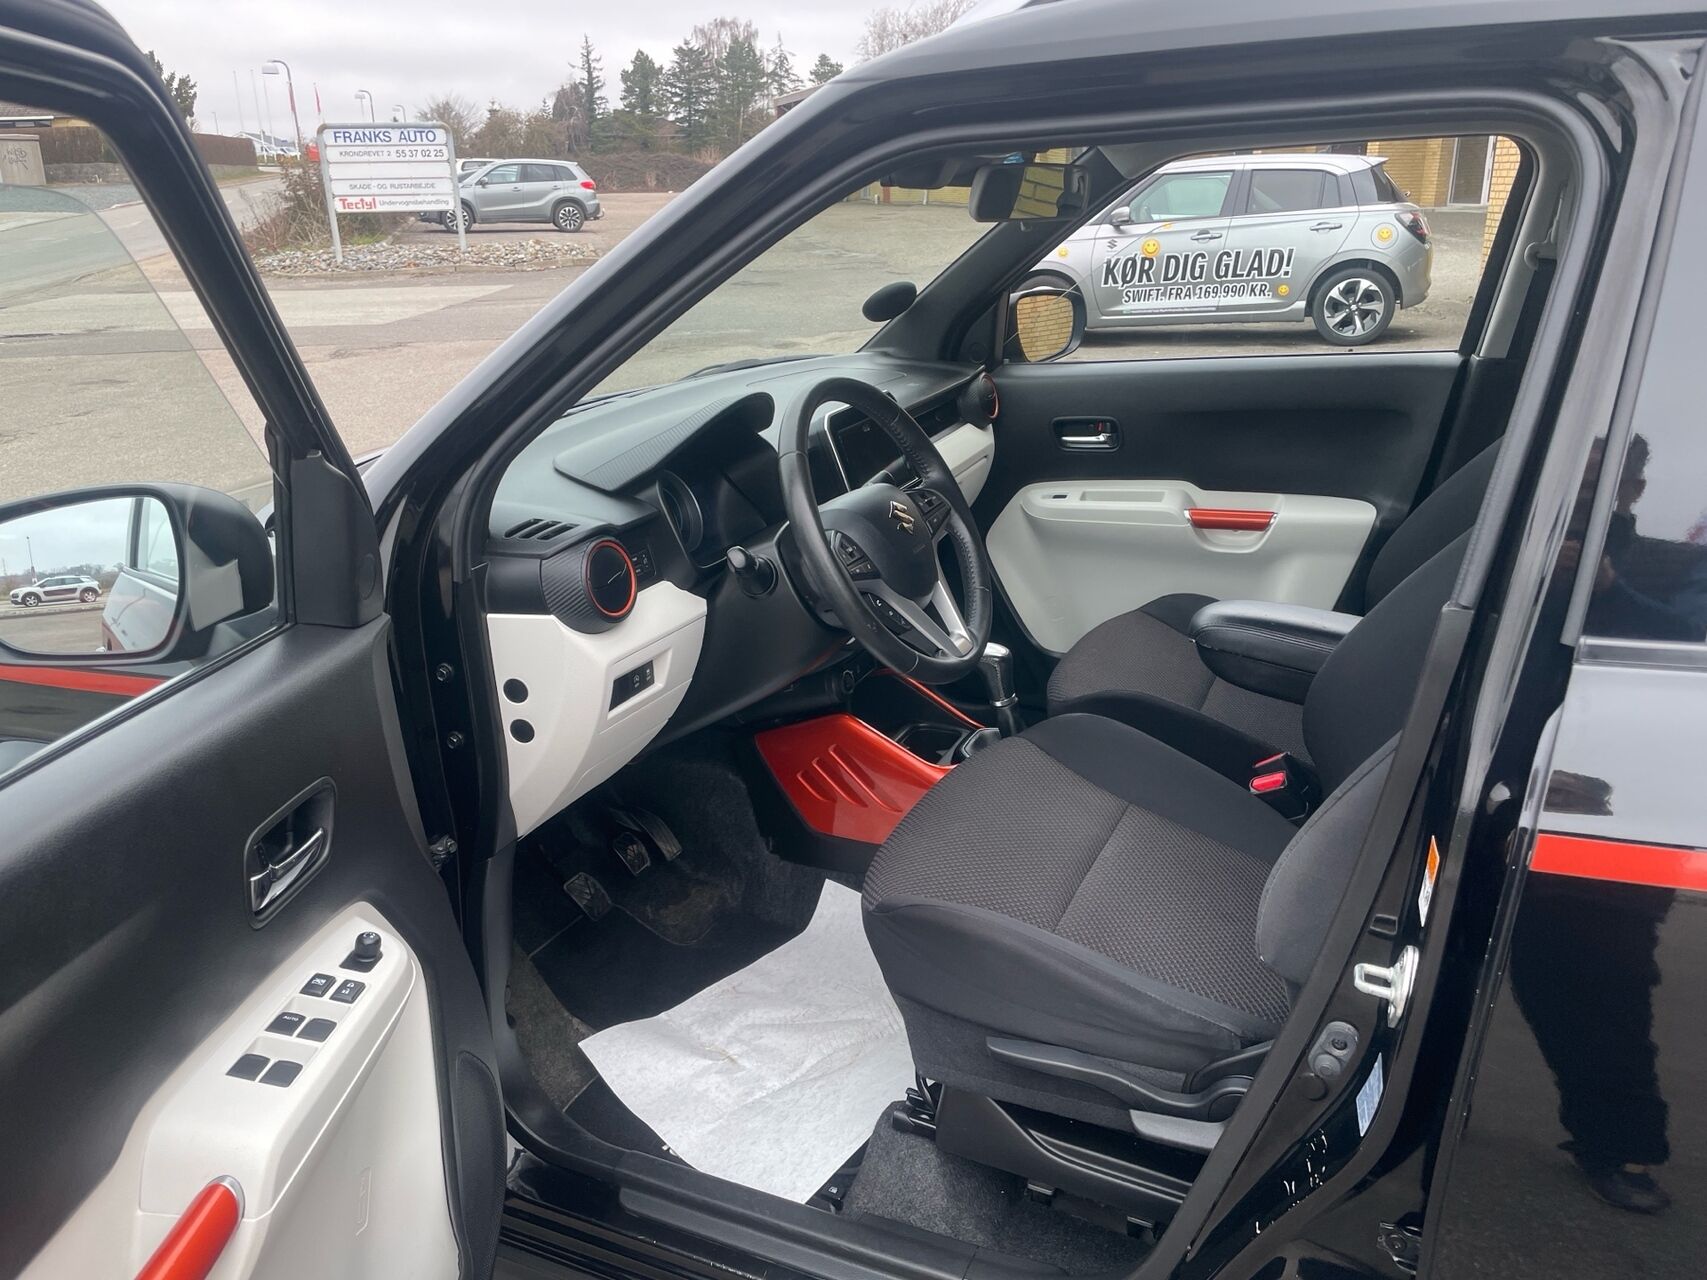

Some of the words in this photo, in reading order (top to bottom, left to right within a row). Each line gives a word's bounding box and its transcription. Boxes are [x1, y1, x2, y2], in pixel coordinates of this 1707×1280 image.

[333, 130, 392, 143] FRANKS
[398, 130, 436, 143] AUTO
[395, 149, 407, 158] 55
[408, 149, 418, 158] 37
[421, 149, 431, 158] 02
[433, 149, 444, 158] 25
[339, 198, 377, 210] Tectyl
[1103, 254, 1155, 287] KØR
[1162, 252, 1206, 283] DIG
[1214, 248, 1294, 280] GLAD!
[1123, 288, 1164, 304] SWIFT.
[1167, 286, 1192, 300] FRA
[1196, 283, 1245, 299] 169.990
[1249, 283, 1272, 298] KR.
